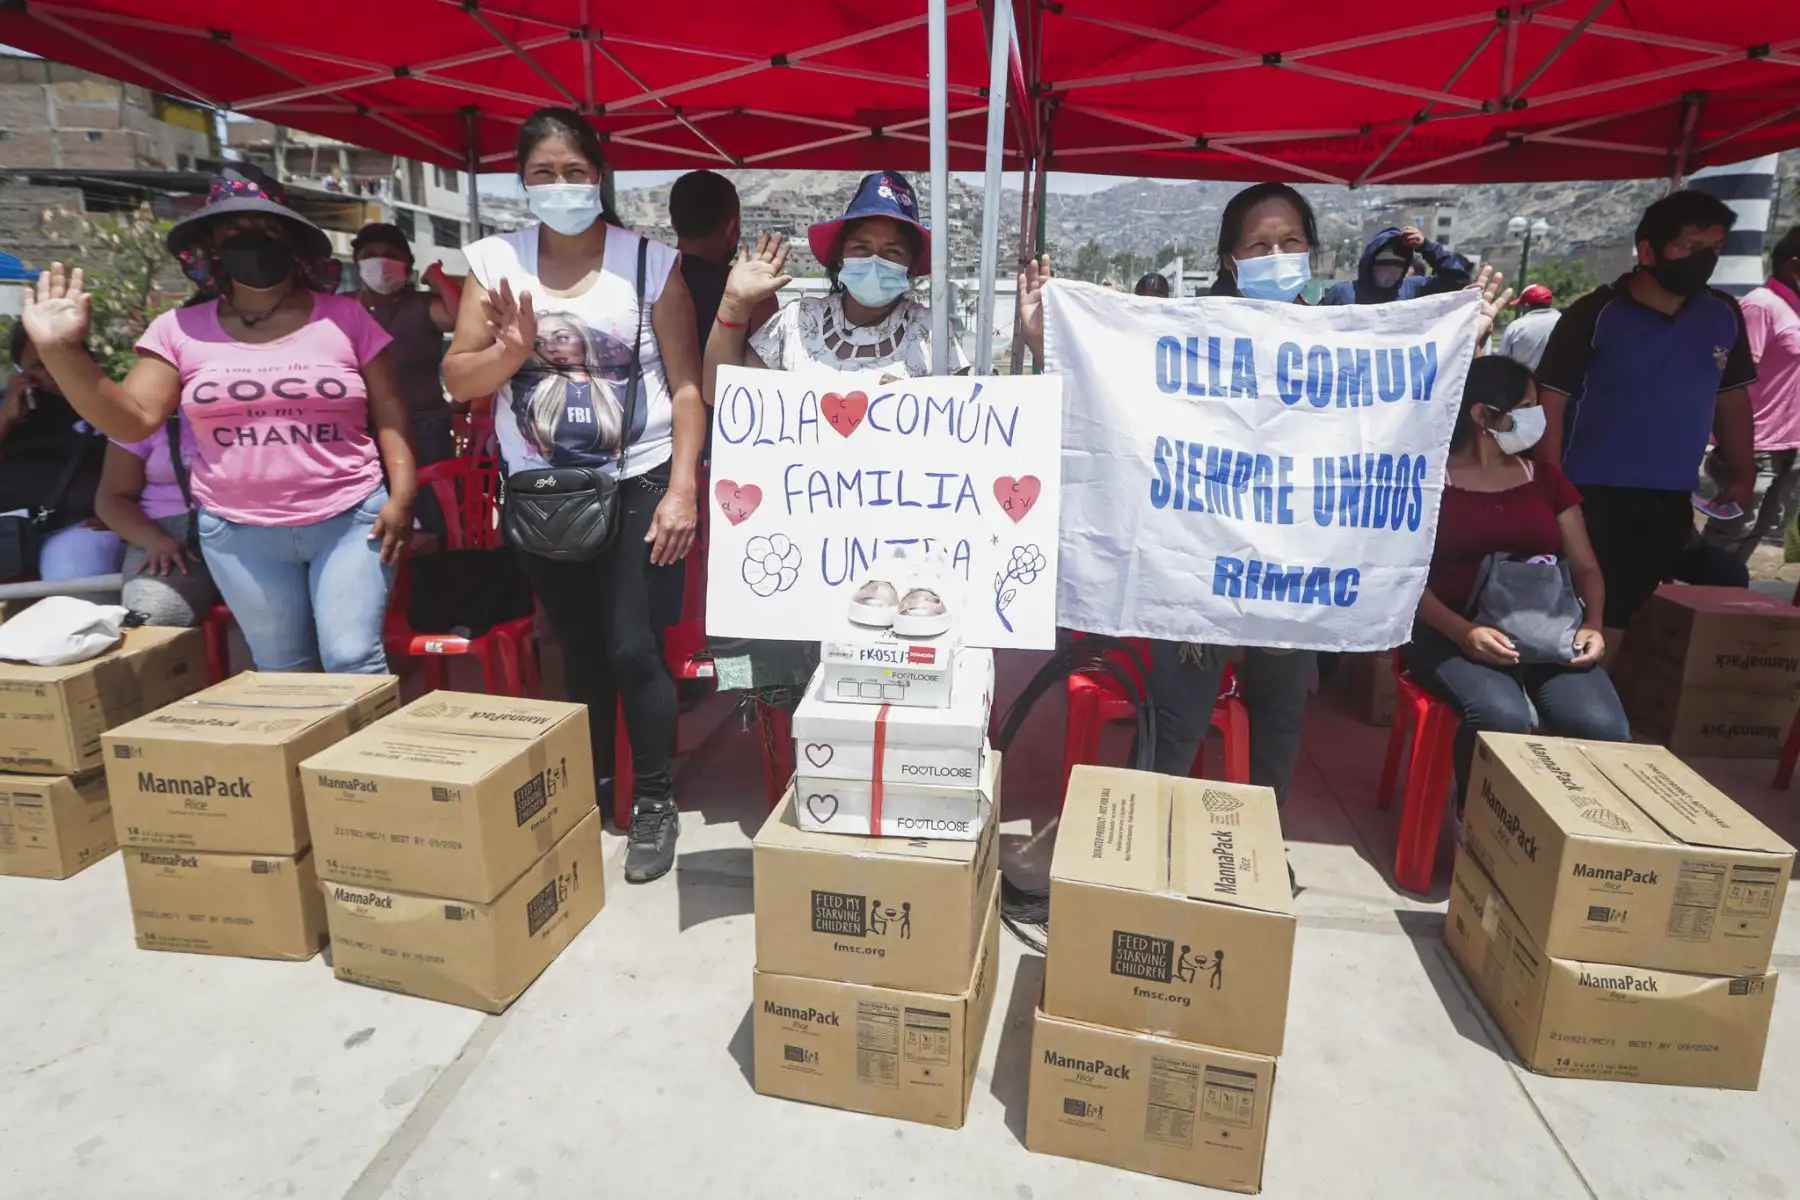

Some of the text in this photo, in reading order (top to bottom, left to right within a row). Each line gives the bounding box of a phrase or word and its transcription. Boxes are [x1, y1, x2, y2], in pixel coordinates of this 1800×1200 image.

[1155, 335, 1437, 409] OLLA COMUN
[192, 377, 347, 404] COCO
[246, 408, 266, 418] to
[567, 406, 592, 424] FBI
[718, 383, 1019, 447] OLLA COMÚN
[212, 422, 344, 448] CHANEL
[784, 463, 981, 516] FAMILIA
[1149, 435, 1427, 533] SIEMPRE UNIDOS
[1212, 555, 1360, 608] RIMAC
[138, 771, 252, 798] MannaPack
[318, 775, 378, 793] MannaPack
[184, 798, 208, 810] Rice
[1481, 777, 1538, 864] MannaPack
[140, 852, 199, 868] MannaPack
[1210, 830, 1237, 895] MannaPack
[1572, 863, 1658, 885] MannaPack
[334, 888, 393, 909] MannaPack
[816, 894, 861, 911] FEED MY
[816, 906, 861, 922] STARVING
[816, 918, 861, 935] CHILDREN
[833, 941, 886, 958] fmsc.org
[1117, 934, 1167, 953] FEED MY
[1116, 949, 1167, 967] STARVING
[1115, 961, 1166, 980] CHILDREN
[1578, 972, 1658, 993] MannaPack
[1133, 986, 1191, 1007] fmsc.org
[764, 1000, 840, 1027] MannaPack
[1628, 1040, 1653, 1049] BEST
[1043, 1050, 1131, 1080] MannaPack
